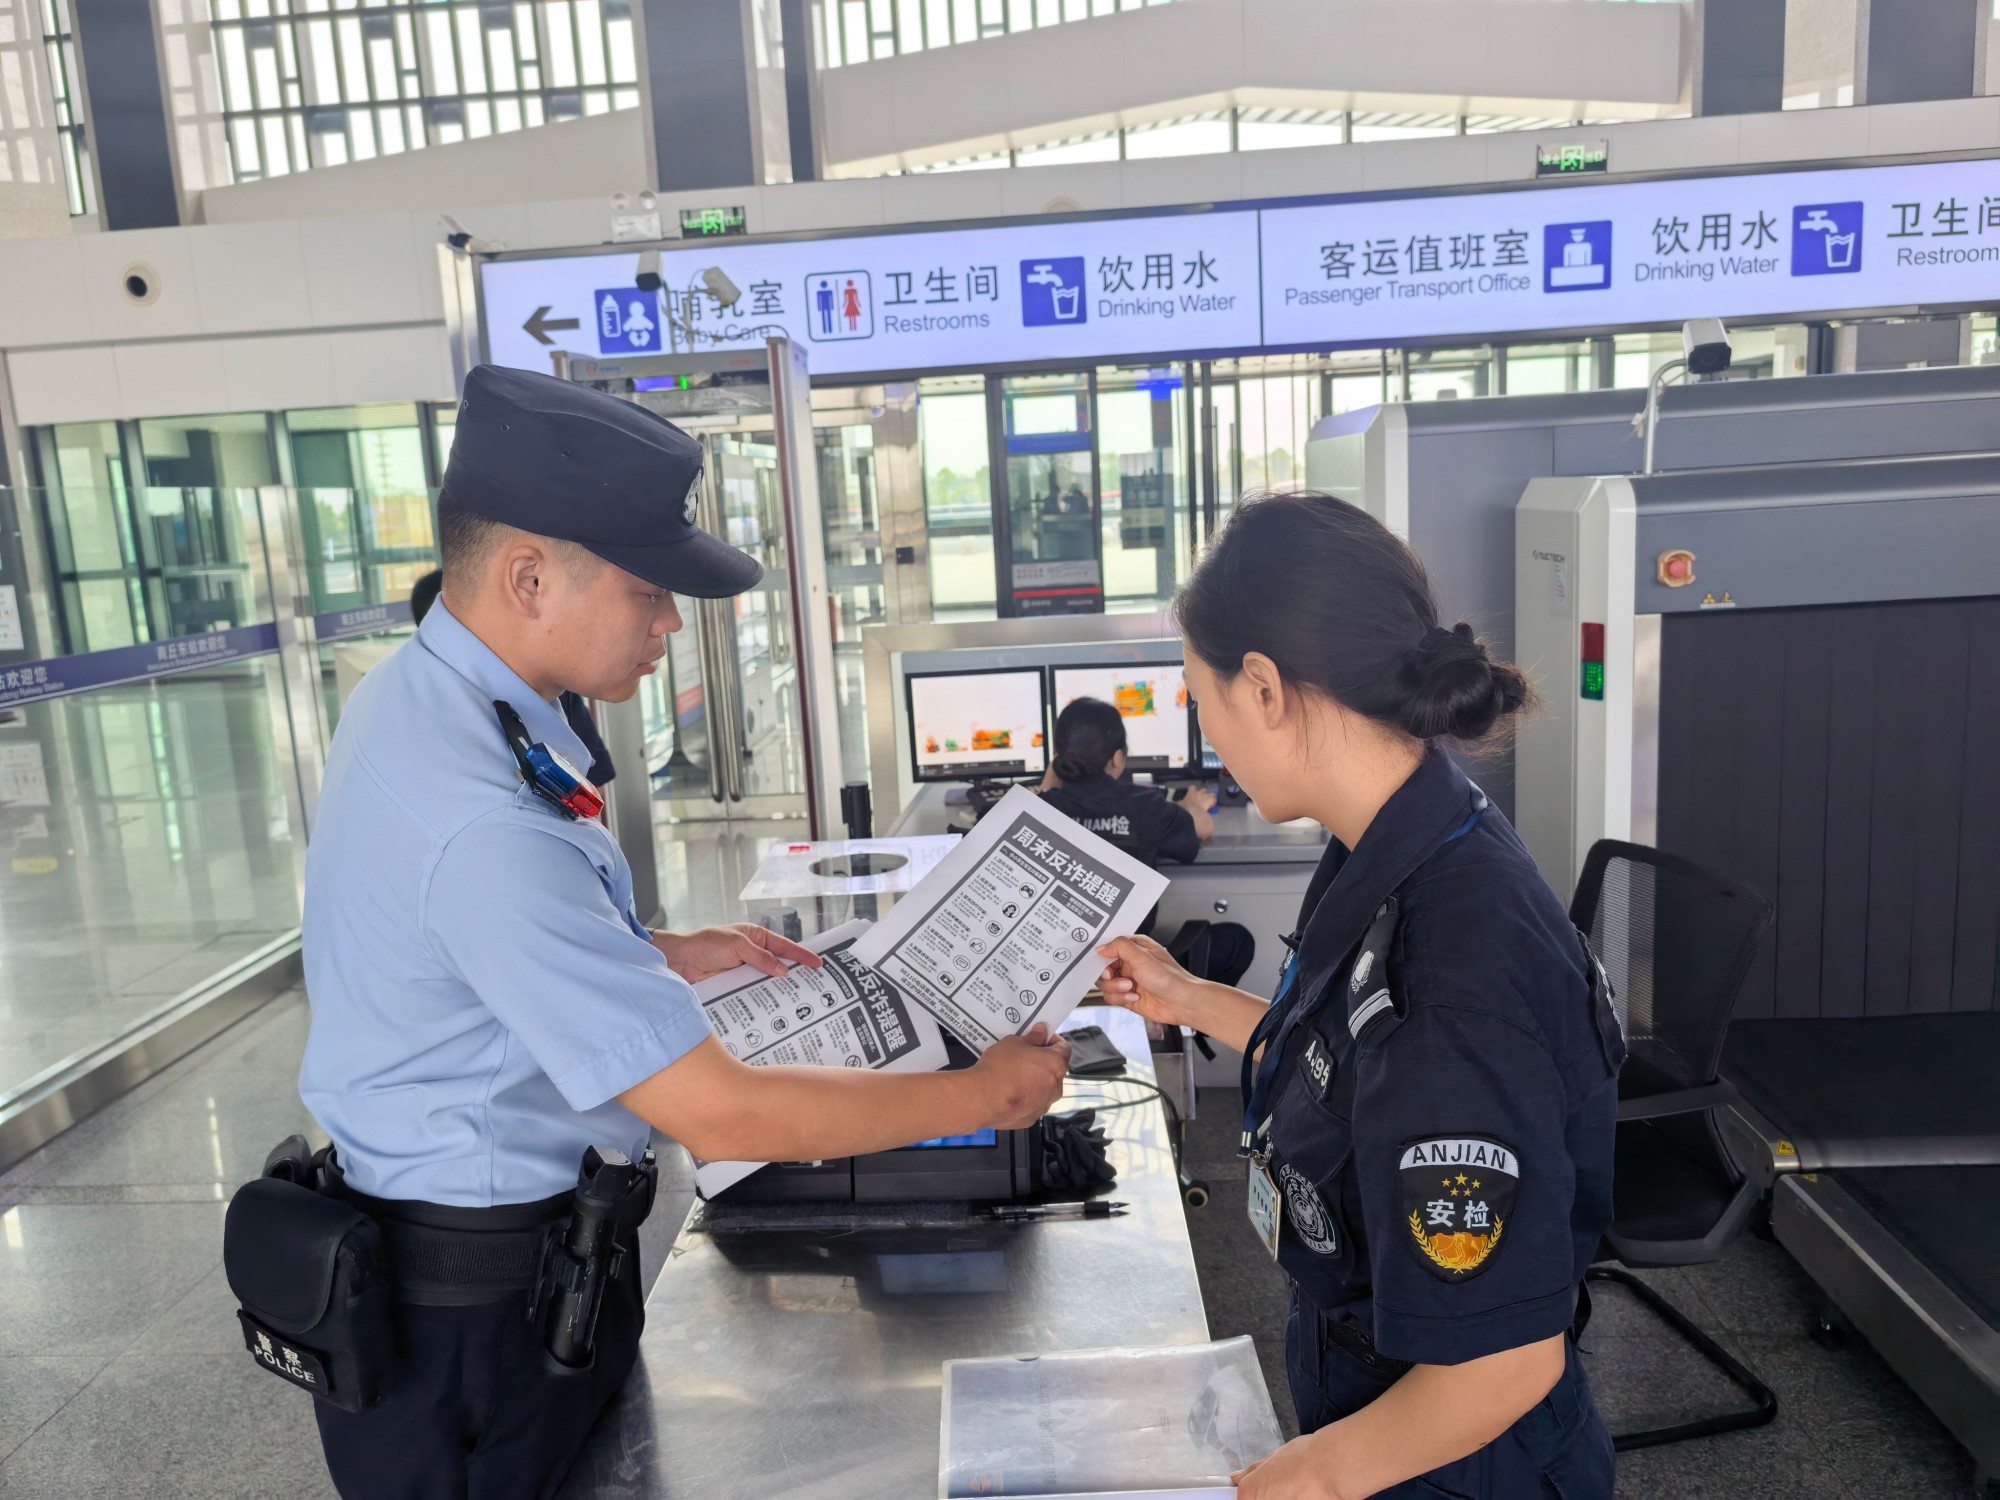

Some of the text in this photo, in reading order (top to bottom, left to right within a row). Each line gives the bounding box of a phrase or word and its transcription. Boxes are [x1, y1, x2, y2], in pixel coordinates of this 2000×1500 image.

[1651, 209, 1779, 257] 饮用水
[1886, 196, 2000, 239] 卫生间
[1098, 253, 1219, 294] 饮用水
[1320, 228, 1529, 280] 客运值班室
[1635, 254, 1779, 283] Drinking Water
[884, 265, 1000, 306] 卫生间
[1285, 273, 1531, 307] Passenger Transport Office
[884, 311, 990, 333] Restrooms
[1098, 294, 1236, 319] Drinking Water
[1012, 825, 1121, 908] 周末反诈提醒
[834, 949, 907, 1053] 周末反诈提醒
[1412, 1143, 1506, 1169] ANJIAN
[1426, 1199, 1490, 1229] 安检
[254, 1344, 316, 1384] POLICE
